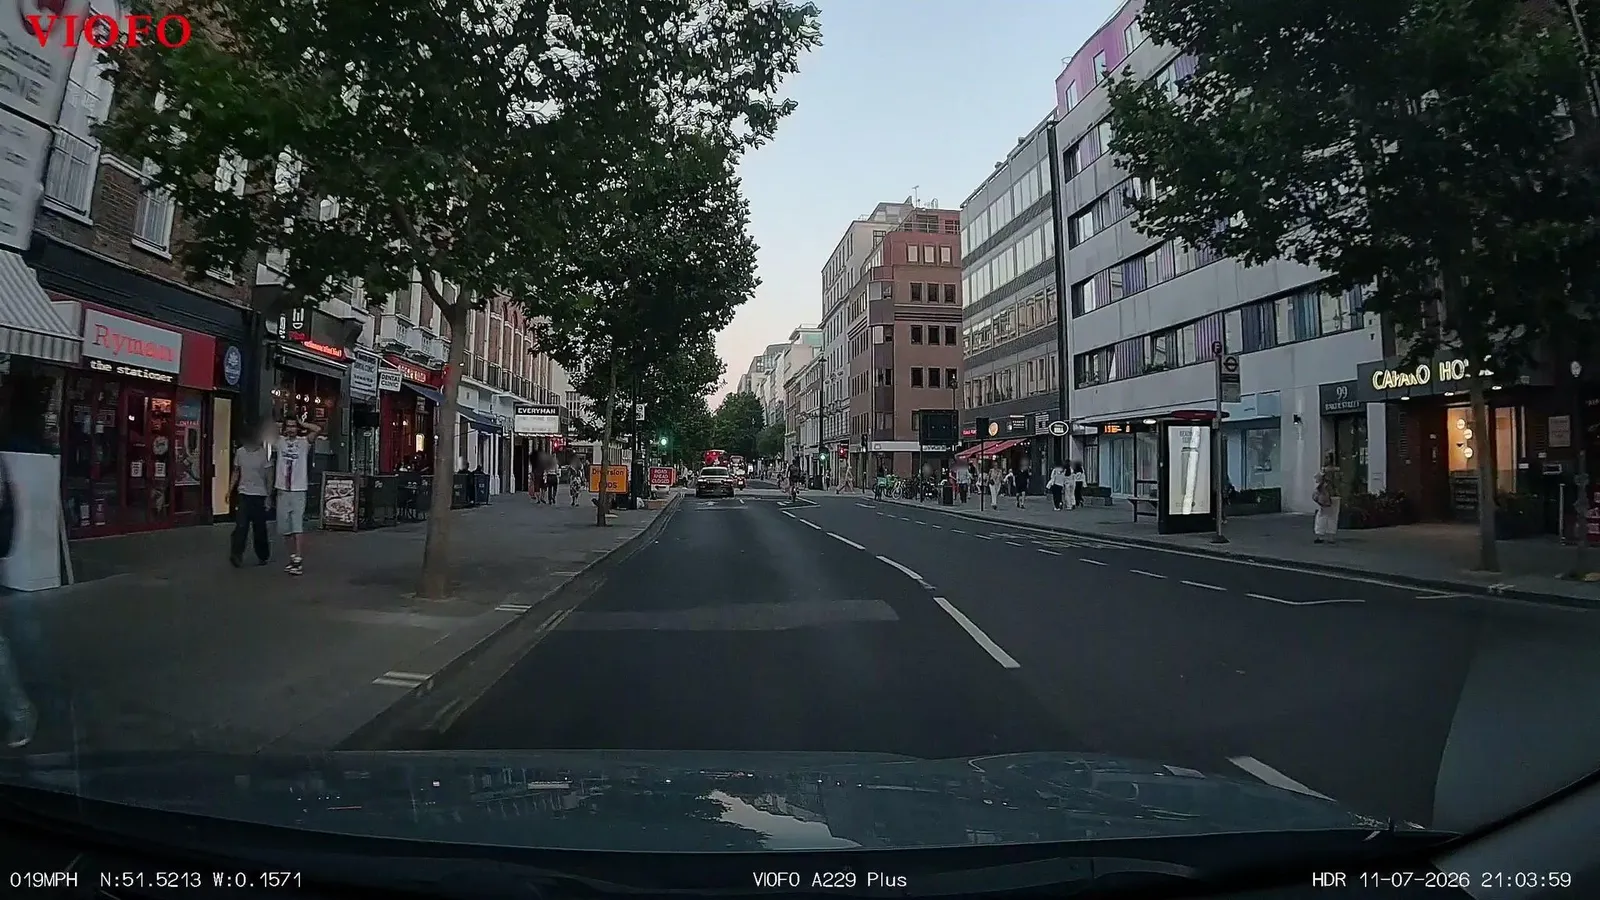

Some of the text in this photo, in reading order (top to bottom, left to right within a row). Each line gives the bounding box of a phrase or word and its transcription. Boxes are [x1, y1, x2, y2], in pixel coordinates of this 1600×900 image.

[92, 323, 174, 361] Ryman
[89, 359, 173, 383] the stationer
[381, 373, 400, 383] DENTAL
[380, 380, 399, 388] CLINIC
[1336, 385, 1348, 400] 99
